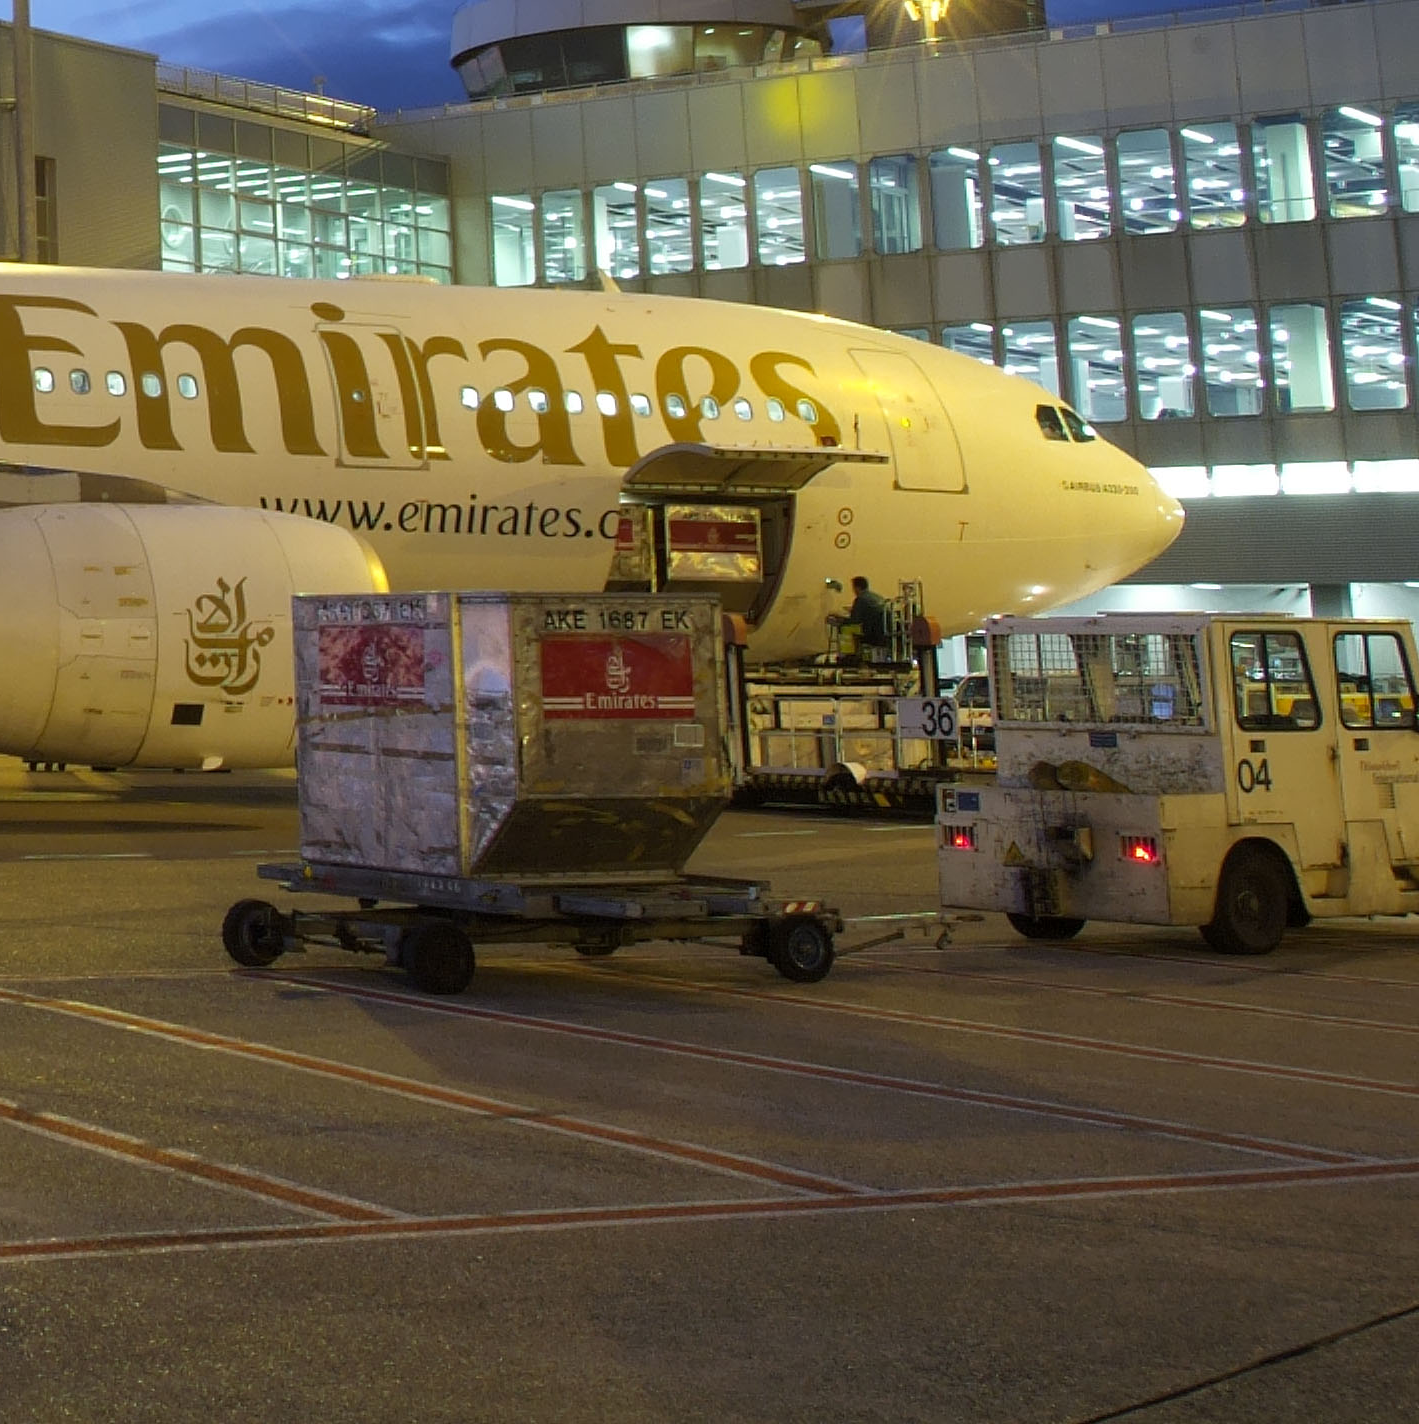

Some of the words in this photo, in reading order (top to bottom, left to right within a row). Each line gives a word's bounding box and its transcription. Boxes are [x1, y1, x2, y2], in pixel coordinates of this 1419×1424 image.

[543, 609, 587, 630] AKE
[598, 610, 649, 630] 1687
[660, 610, 690, 630] EK
[585, 691, 657, 710] Emirates
[921, 700, 954, 737] 36
[1237, 758, 1272, 794] 04
